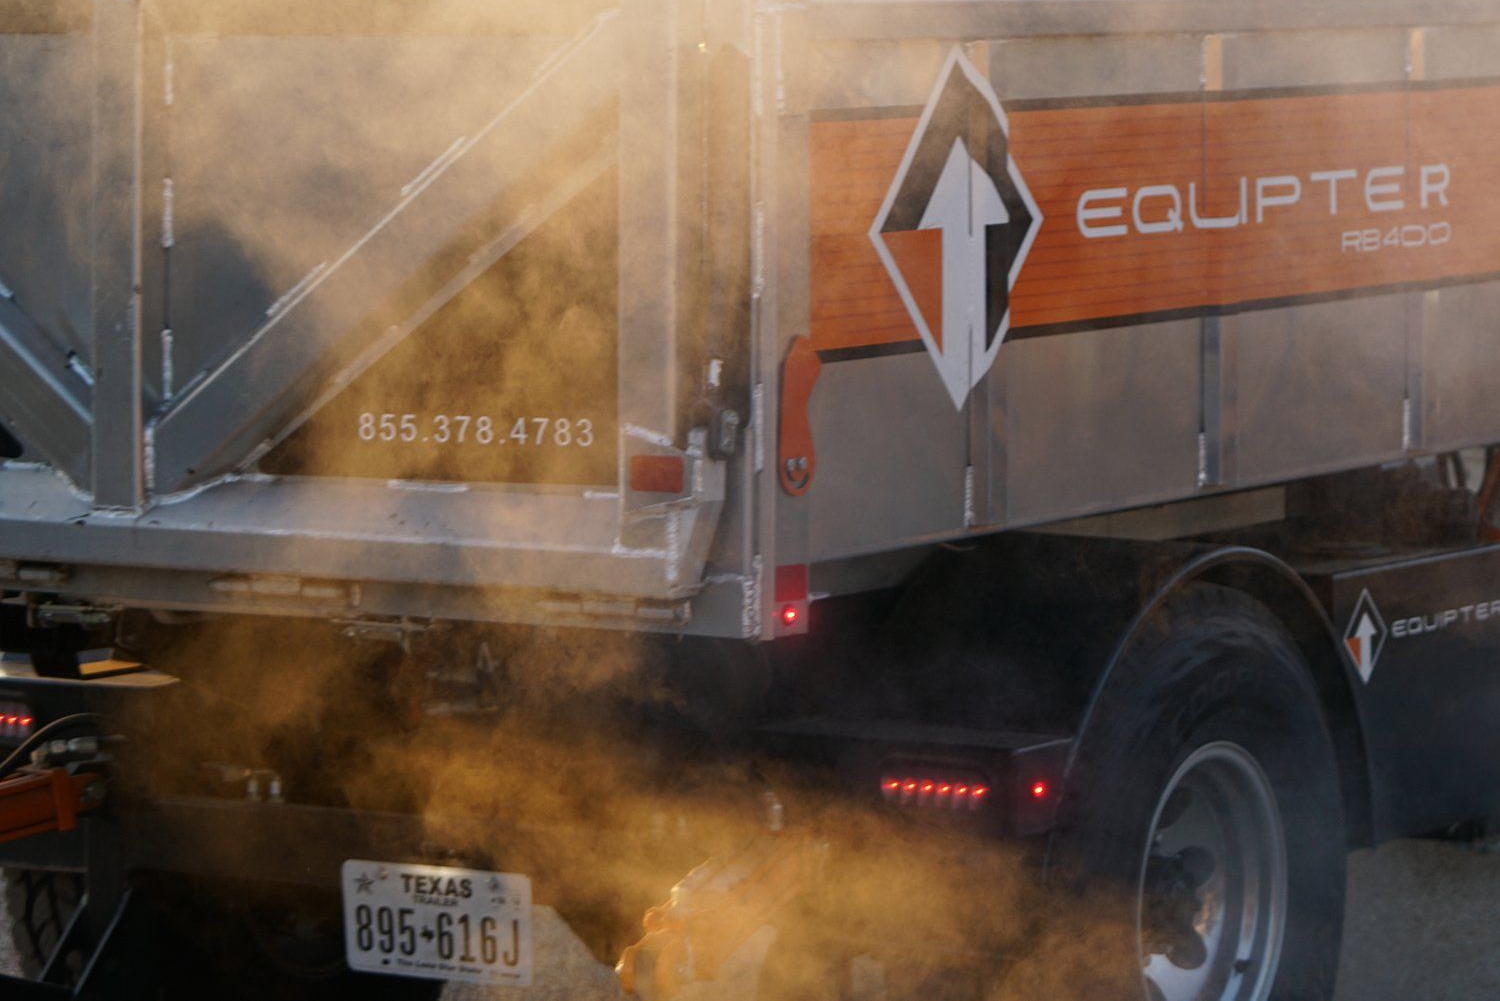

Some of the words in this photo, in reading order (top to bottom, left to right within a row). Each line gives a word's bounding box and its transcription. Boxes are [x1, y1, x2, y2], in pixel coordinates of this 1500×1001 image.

[1076, 163, 1451, 238] EQUIPTER
[1341, 221, 1452, 253] RB400
[357, 412, 595, 447] 855.378.4783
[400, 874, 473, 898] TEXAS
[412, 895, 459, 907] TRAILER
